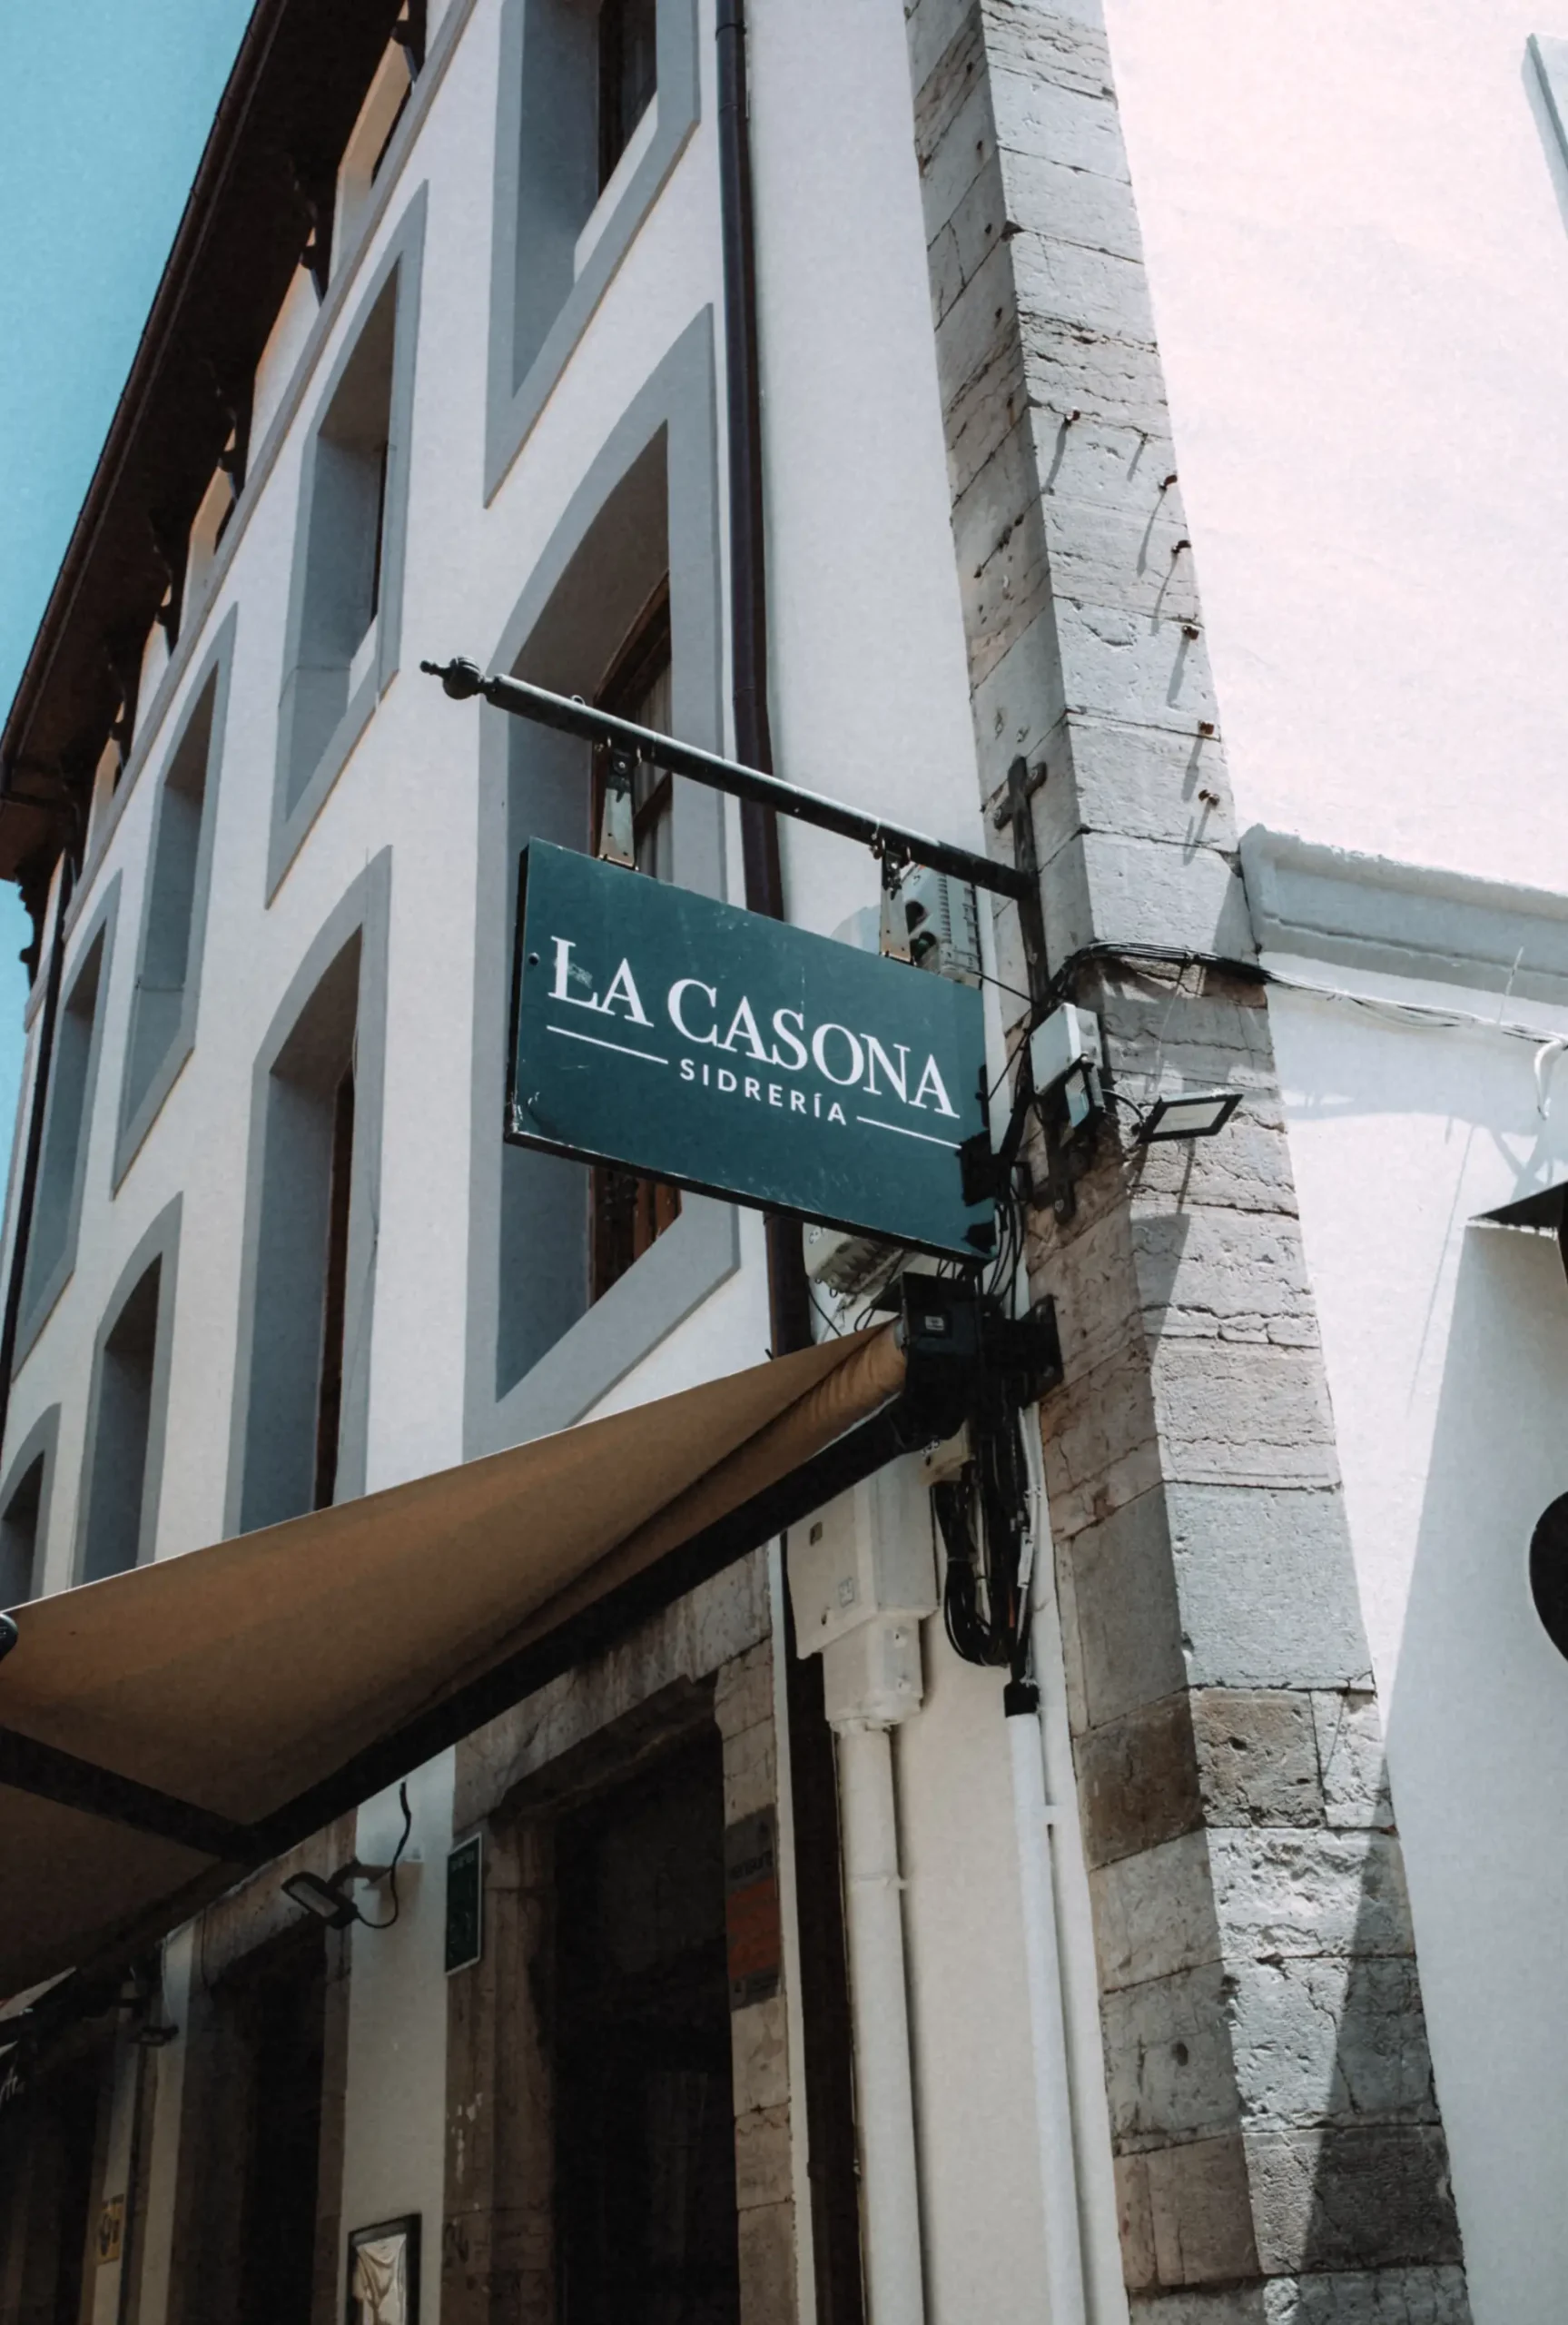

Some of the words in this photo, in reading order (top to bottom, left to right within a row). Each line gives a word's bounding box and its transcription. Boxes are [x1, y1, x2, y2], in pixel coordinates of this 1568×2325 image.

[548, 936, 654, 1027] LA
[667, 978, 961, 1119] CASONA
[679, 1058, 847, 1125] SIDRERÍA
